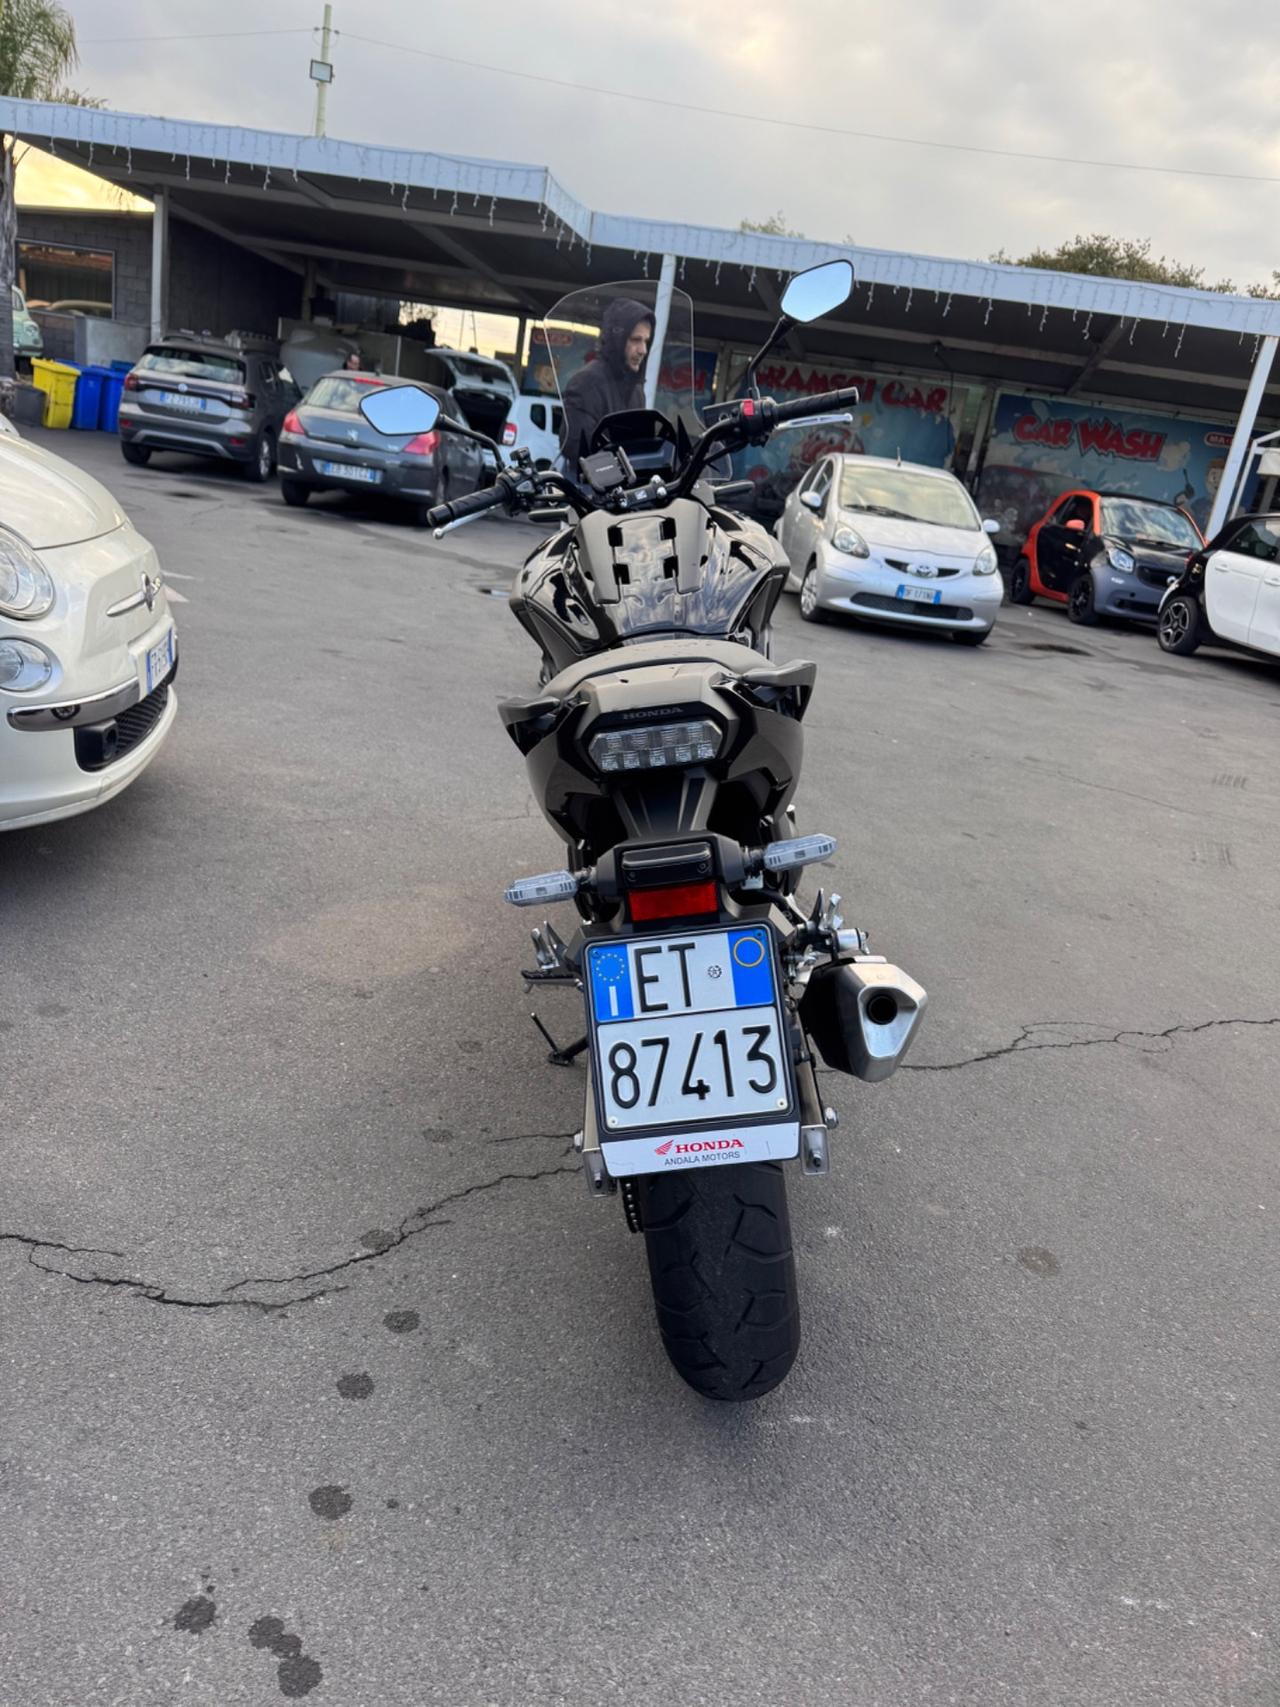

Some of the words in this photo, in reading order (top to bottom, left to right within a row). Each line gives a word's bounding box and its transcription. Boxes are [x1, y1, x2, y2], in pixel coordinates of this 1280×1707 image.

[881, 382, 947, 412] CAR
[1013, 415, 1073, 447] CAR
[1078, 418, 1168, 461] WASH
[623, 706, 684, 720] HONDA
[634, 942, 696, 1013] ET
[608, 1024, 778, 1110] 87413
[664, 1155, 700, 1167] ANDALA
[702, 1150, 740, 1162] MOTORS
[675, 1138, 744, 1154] HONDA
